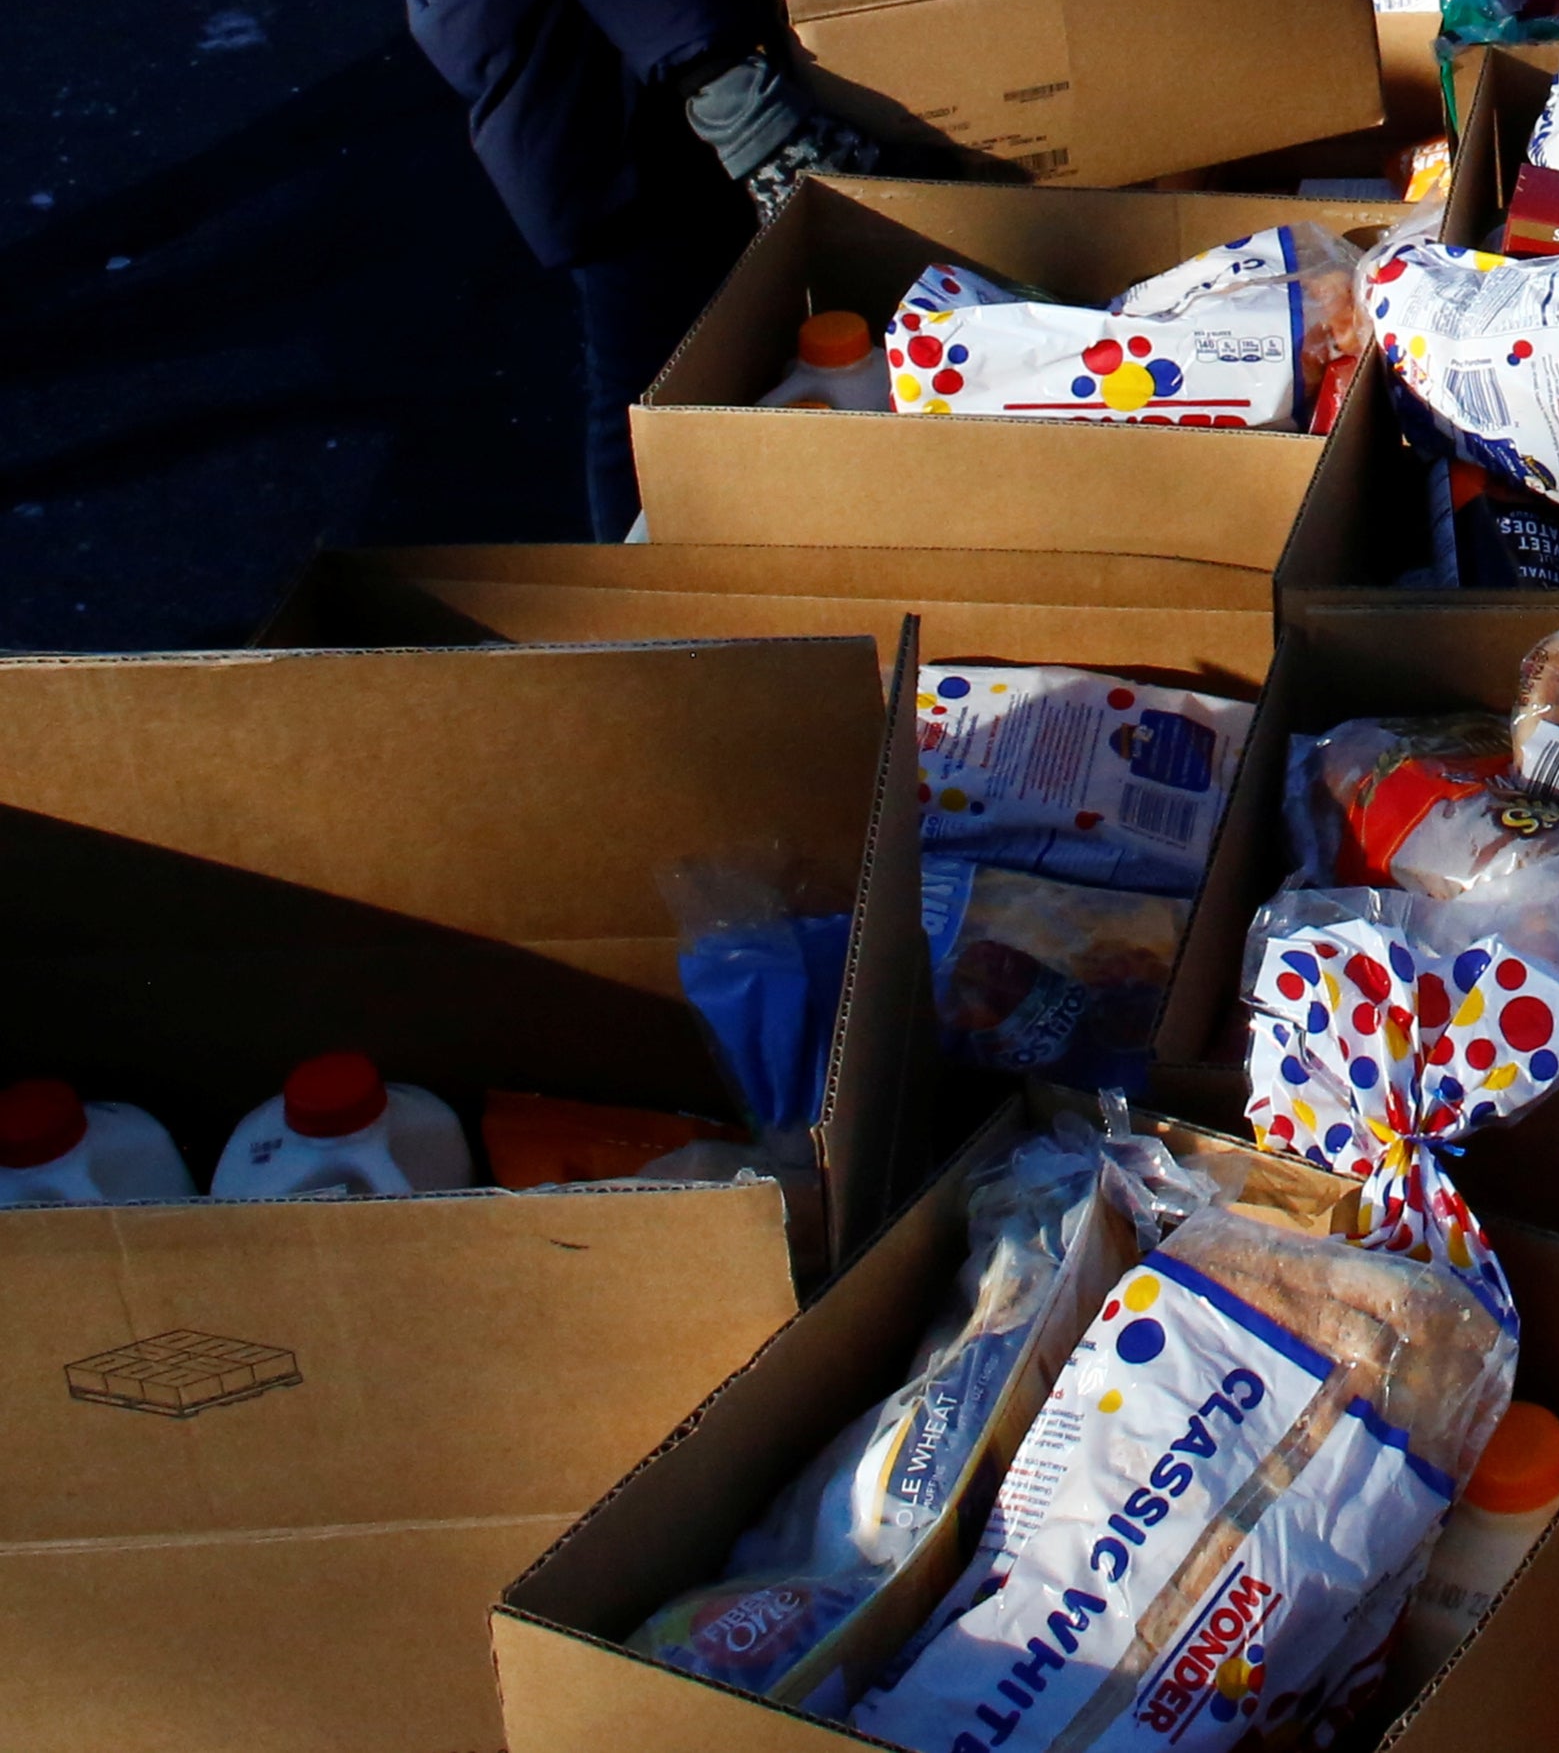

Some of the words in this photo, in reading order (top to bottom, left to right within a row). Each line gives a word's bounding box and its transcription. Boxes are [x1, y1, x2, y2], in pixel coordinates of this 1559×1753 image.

[914, 1391, 961, 1481] WHEAT
[1093, 1368, 1266, 1583] CLASSIC
[1149, 1573, 1273, 1734] WONDER
